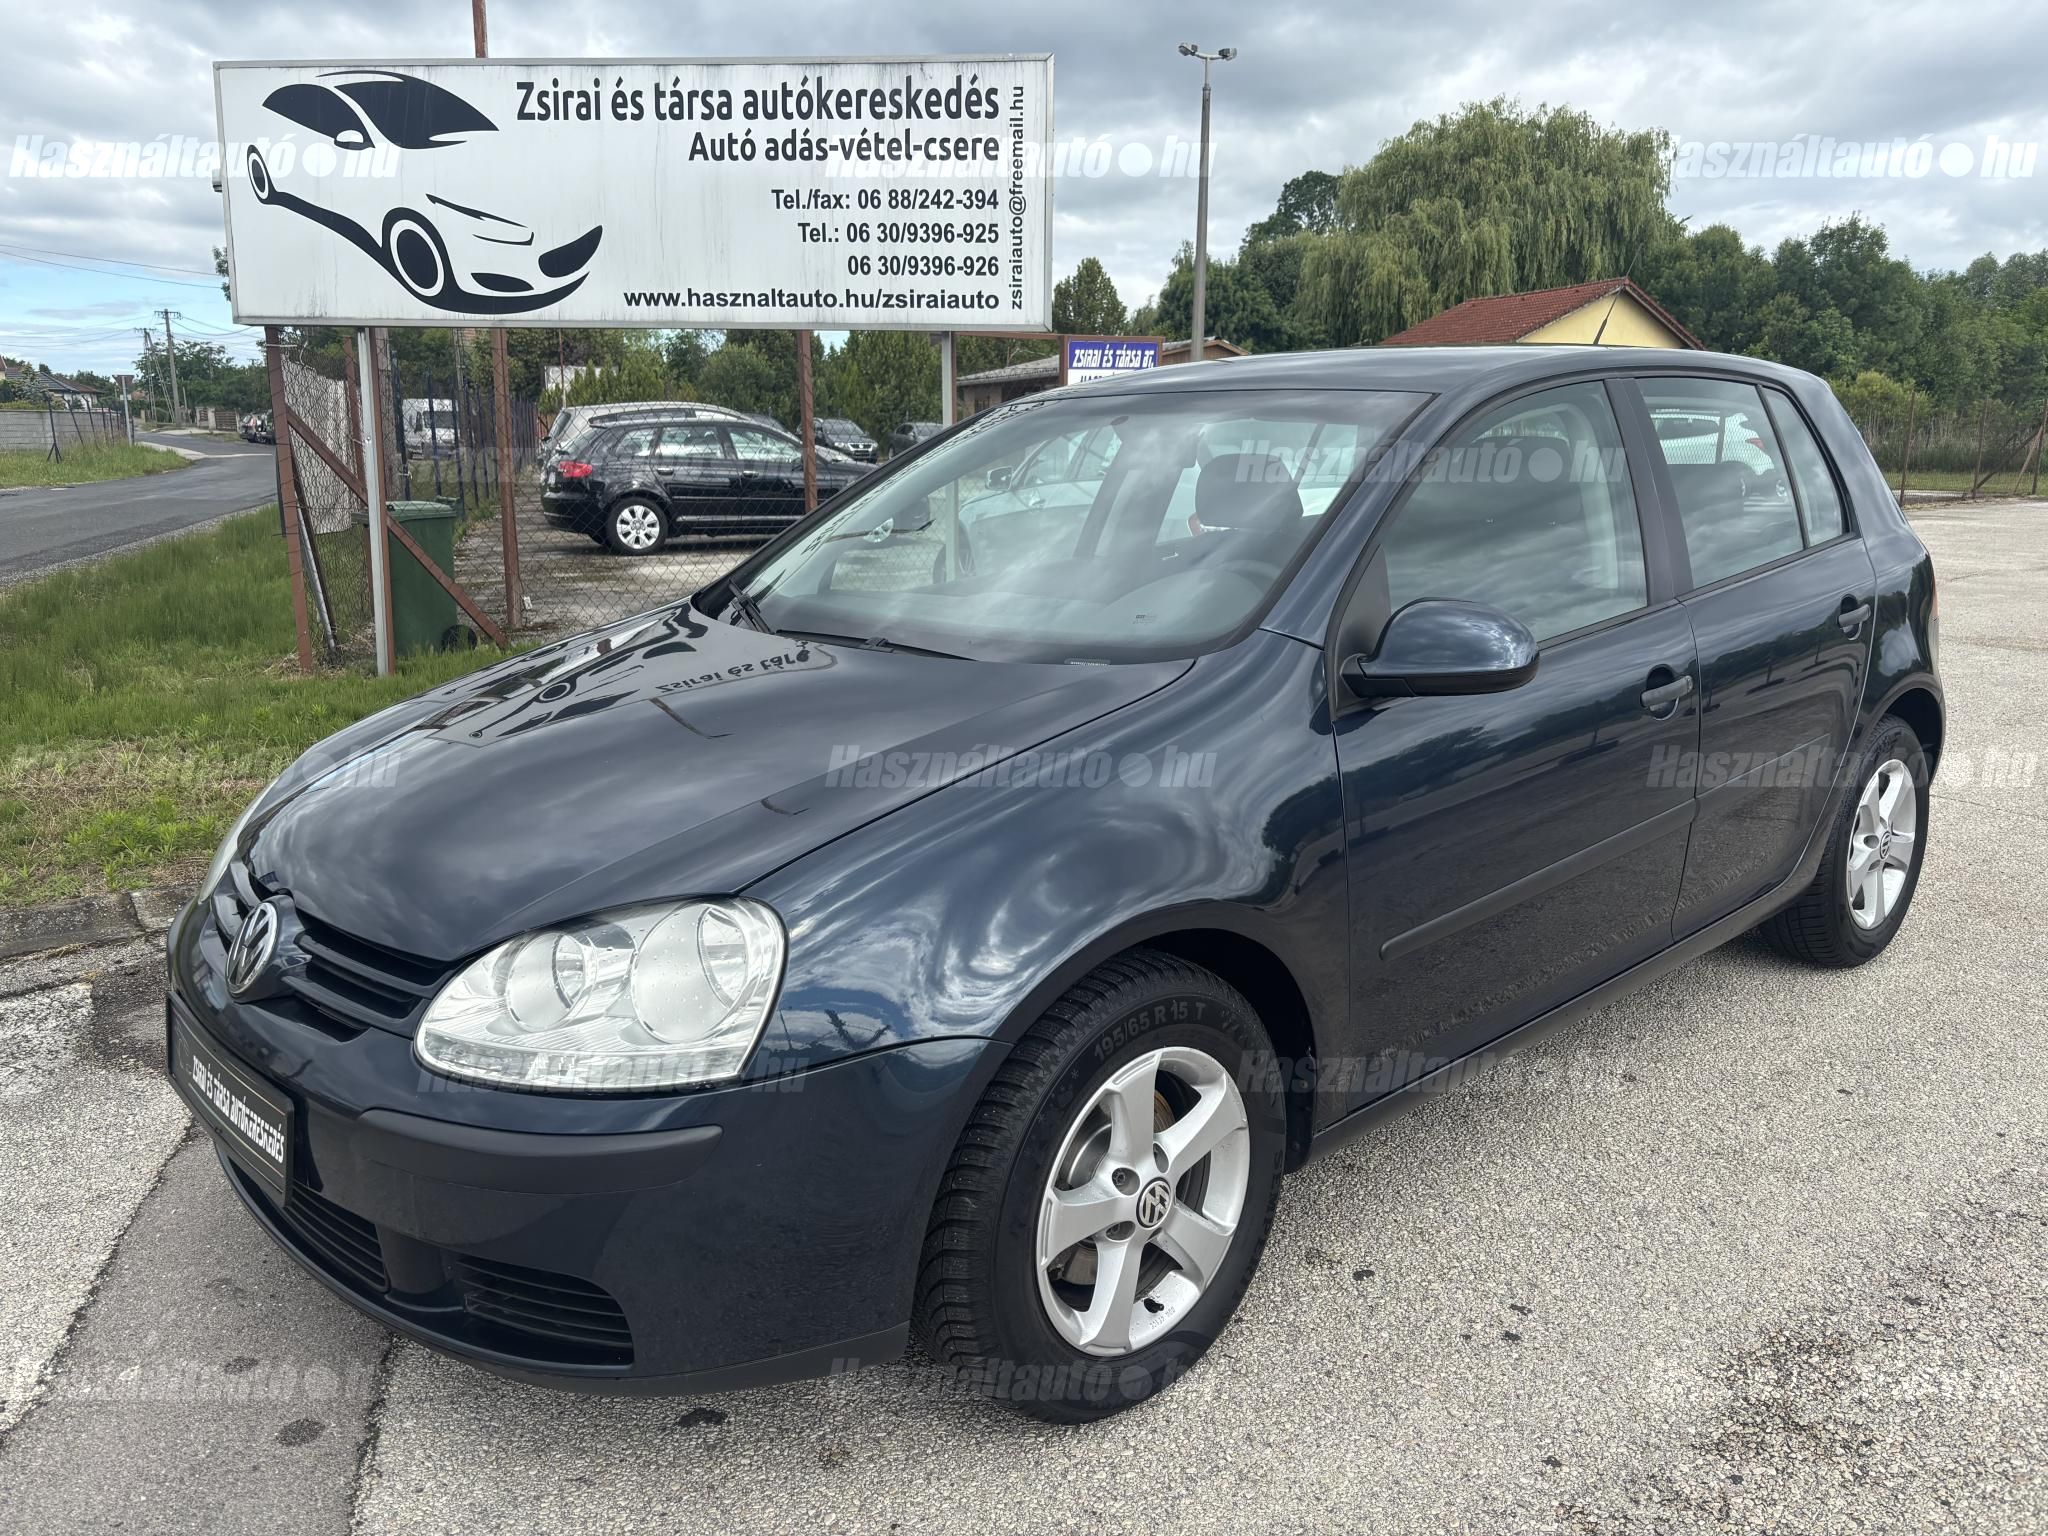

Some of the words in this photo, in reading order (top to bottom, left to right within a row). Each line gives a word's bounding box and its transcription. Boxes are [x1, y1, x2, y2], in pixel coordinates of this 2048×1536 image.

[516, 77, 601, 121] Zsirai
[611, 76, 645, 121] és
[654, 76, 733, 121] társa
[743, 73, 1000, 121] autókereskedés
[689, 127, 757, 162] Autó
[764, 127, 1000, 161] adás-vétel-csere
[771, 189, 851, 210] Tel./fax:
[857, 189, 881, 210] 06
[888, 188, 1000, 210] 88/242-394
[1008, 85, 1027, 311] zsiraiauto@freemail.hu
[798, 223, 839, 243] Tel.:
[846, 223, 871, 243] 06
[877, 222, 1000, 243] 30/9396-925
[848, 255, 871, 276] 06
[878, 255, 1000, 276] 30/9396-926
[623, 288, 1000, 310] www.hasznaltauto.hu/zsiraiauto
[1154, 1005, 1167, 1025] R
